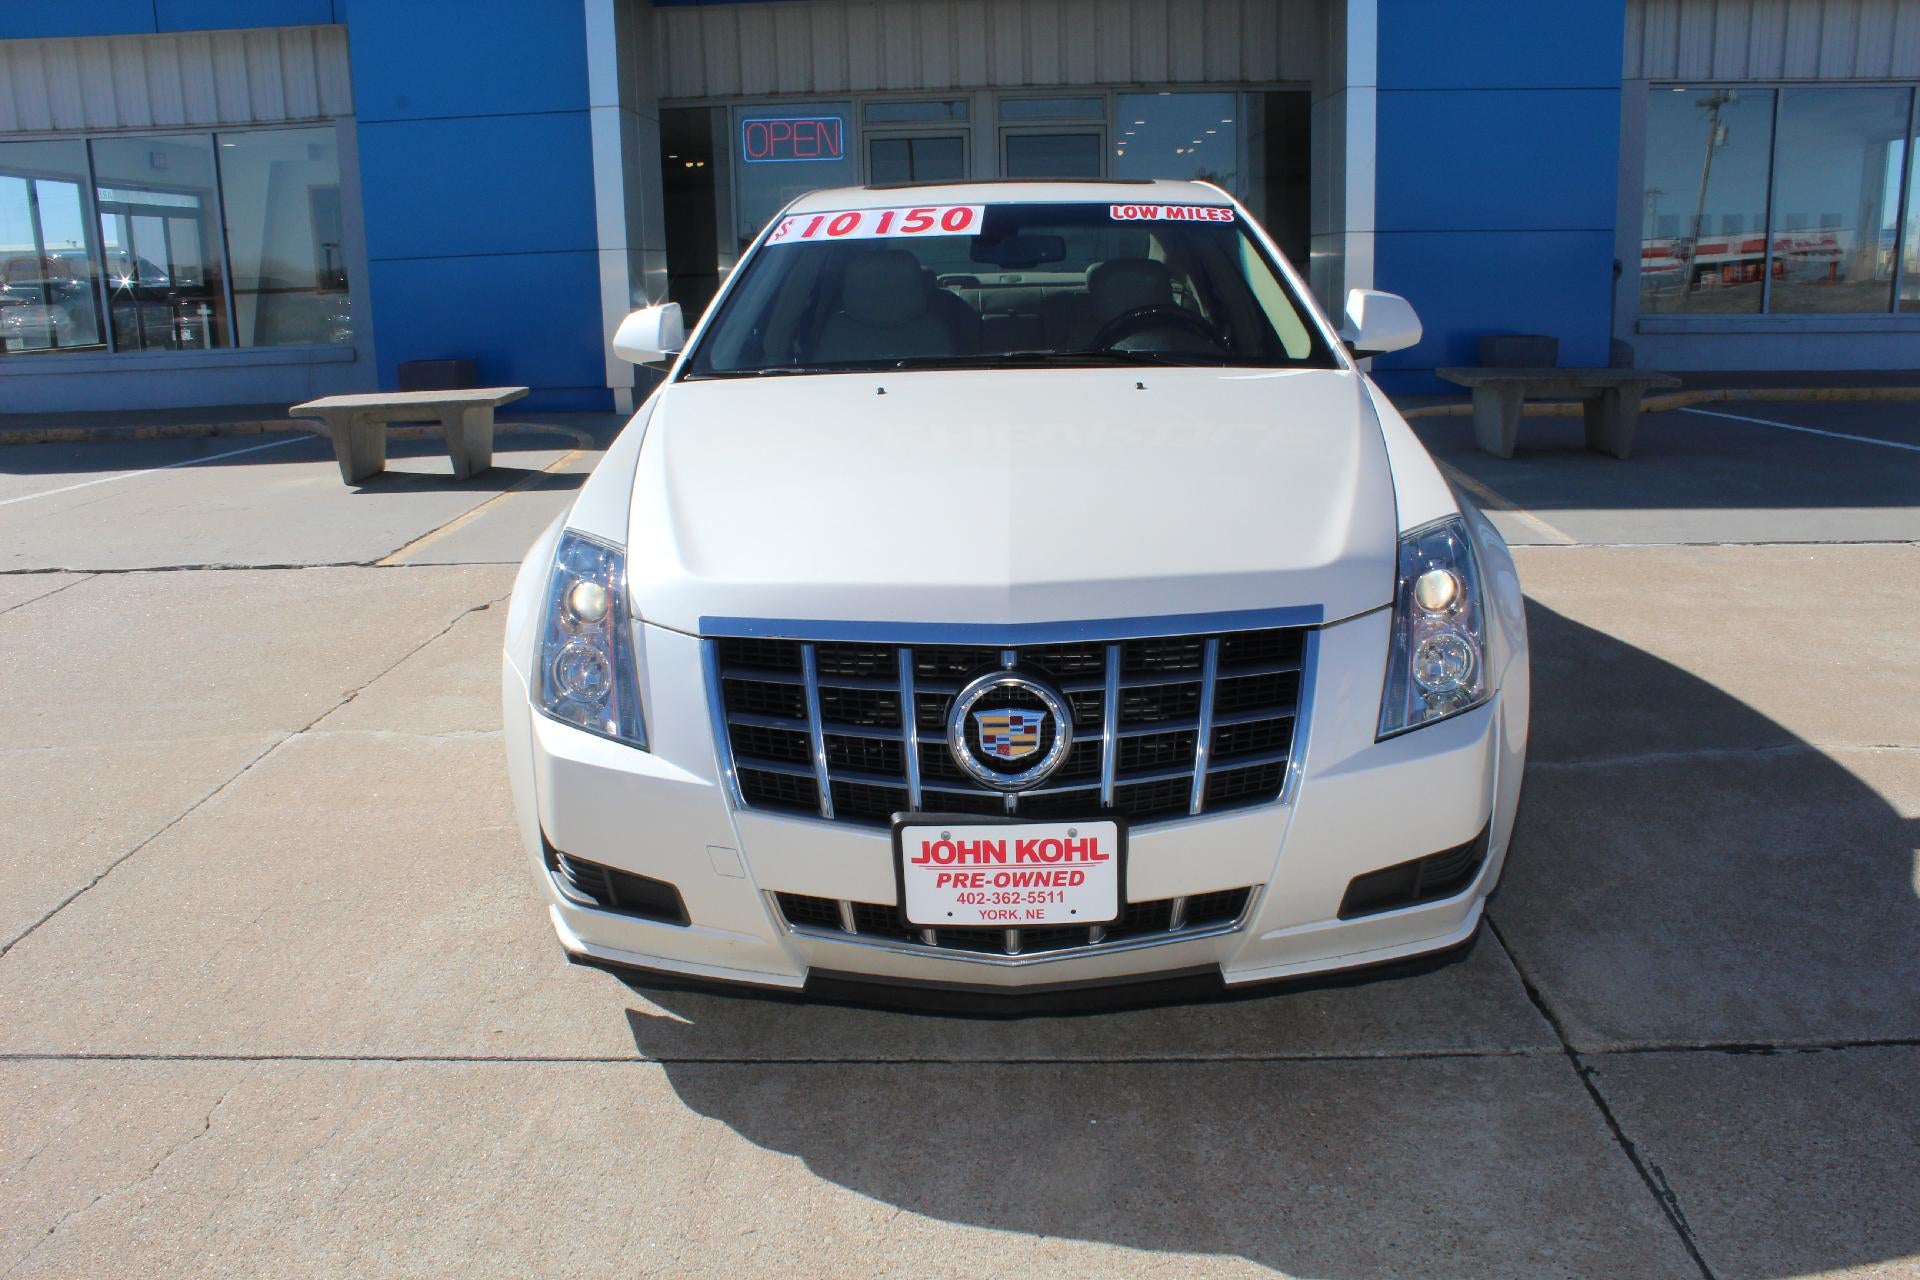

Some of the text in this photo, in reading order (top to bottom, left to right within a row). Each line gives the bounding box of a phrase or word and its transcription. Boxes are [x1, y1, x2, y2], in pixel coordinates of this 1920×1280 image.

[746, 120, 839, 158] OPEN
[1112, 206, 1233, 221] LOW MILES
[911, 837, 1109, 864] JOHN KOHL
[936, 870, 1085, 889] PRE-OWNED
[956, 890, 1065, 905] 402-362-5511
[979, 908, 1045, 921] YORK, NE
